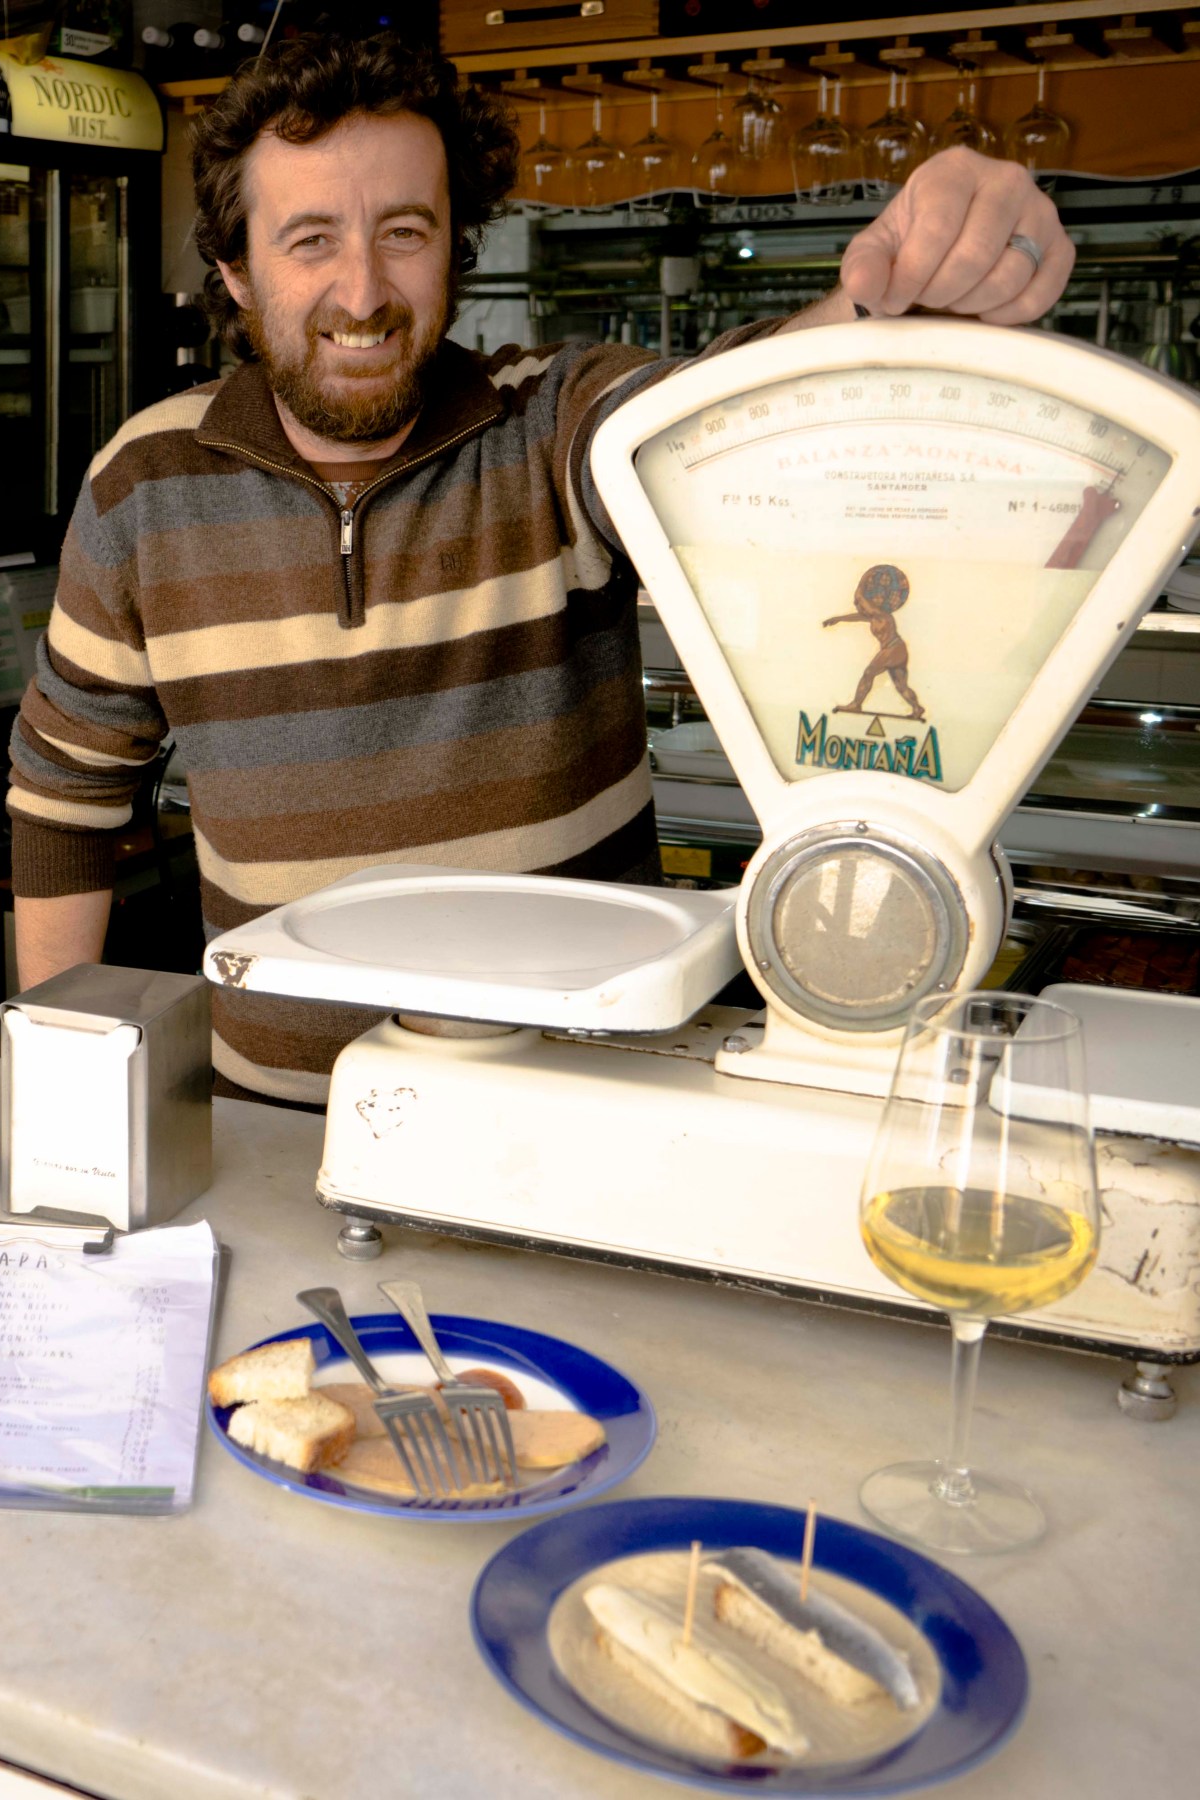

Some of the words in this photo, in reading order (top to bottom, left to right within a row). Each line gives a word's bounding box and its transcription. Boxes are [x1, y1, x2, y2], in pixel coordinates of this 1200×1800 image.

[68, 115, 106, 140] MIST
[794, 392, 816, 408] 700
[841, 386, 863, 401] 600
[890, 384, 912, 399] 500
[938, 385, 961, 401] 400
[987, 391, 1010, 409] 300
[749, 403, 770, 420] 800
[1036, 403, 1060, 422] 200
[705, 417, 726, 435] 900
[1087, 418, 1108, 439] 100
[777, 446, 889, 471] BALANZA
[866, 483, 929, 492] SANTANDER
[747, 494, 762, 506] 15
